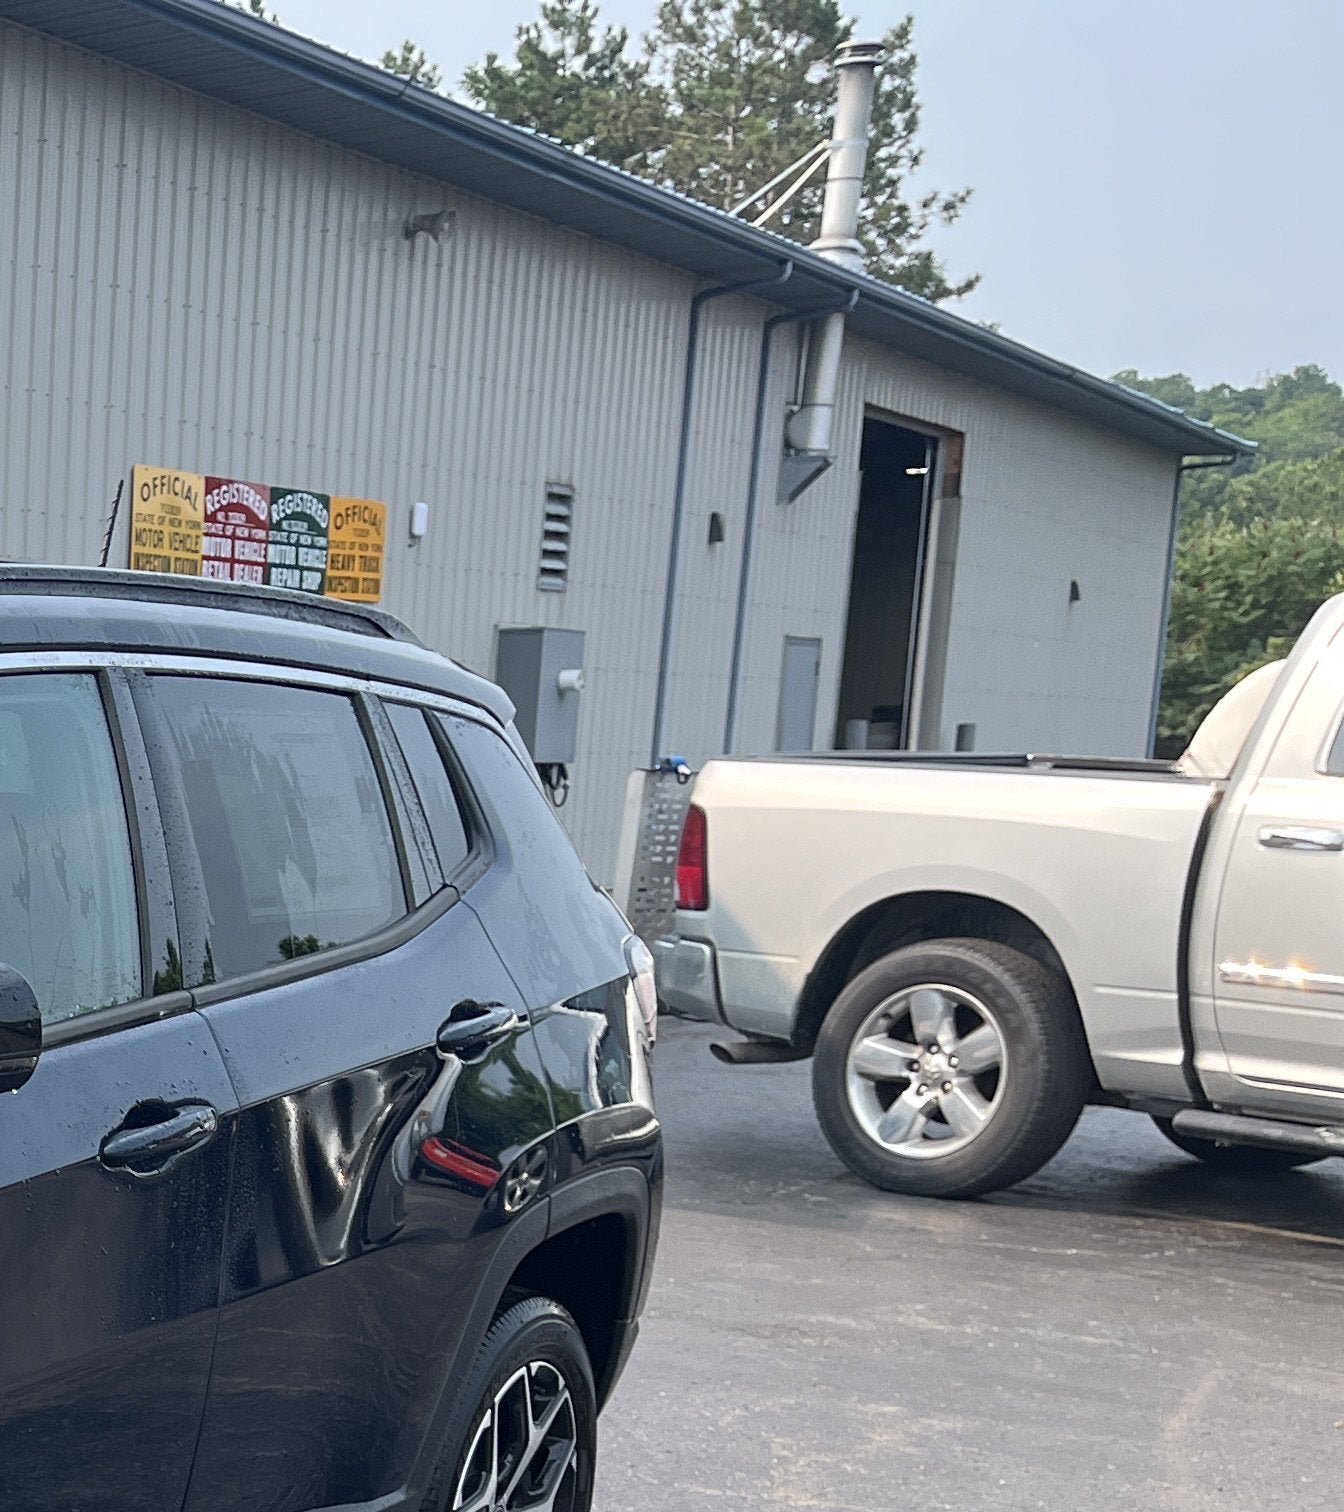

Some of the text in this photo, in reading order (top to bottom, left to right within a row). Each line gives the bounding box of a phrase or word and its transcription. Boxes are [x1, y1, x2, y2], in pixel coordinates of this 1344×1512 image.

[140, 475, 198, 512] OFFICIAL
[205, 483, 268, 520] REGISTERED
[271, 492, 329, 528] REGISTERED
[135, 513, 154, 525] STATE
[158, 516, 166, 525] OF
[334, 505, 382, 536] OFFICIAL
[135, 527, 200, 553] MOTOR VEHICLE
